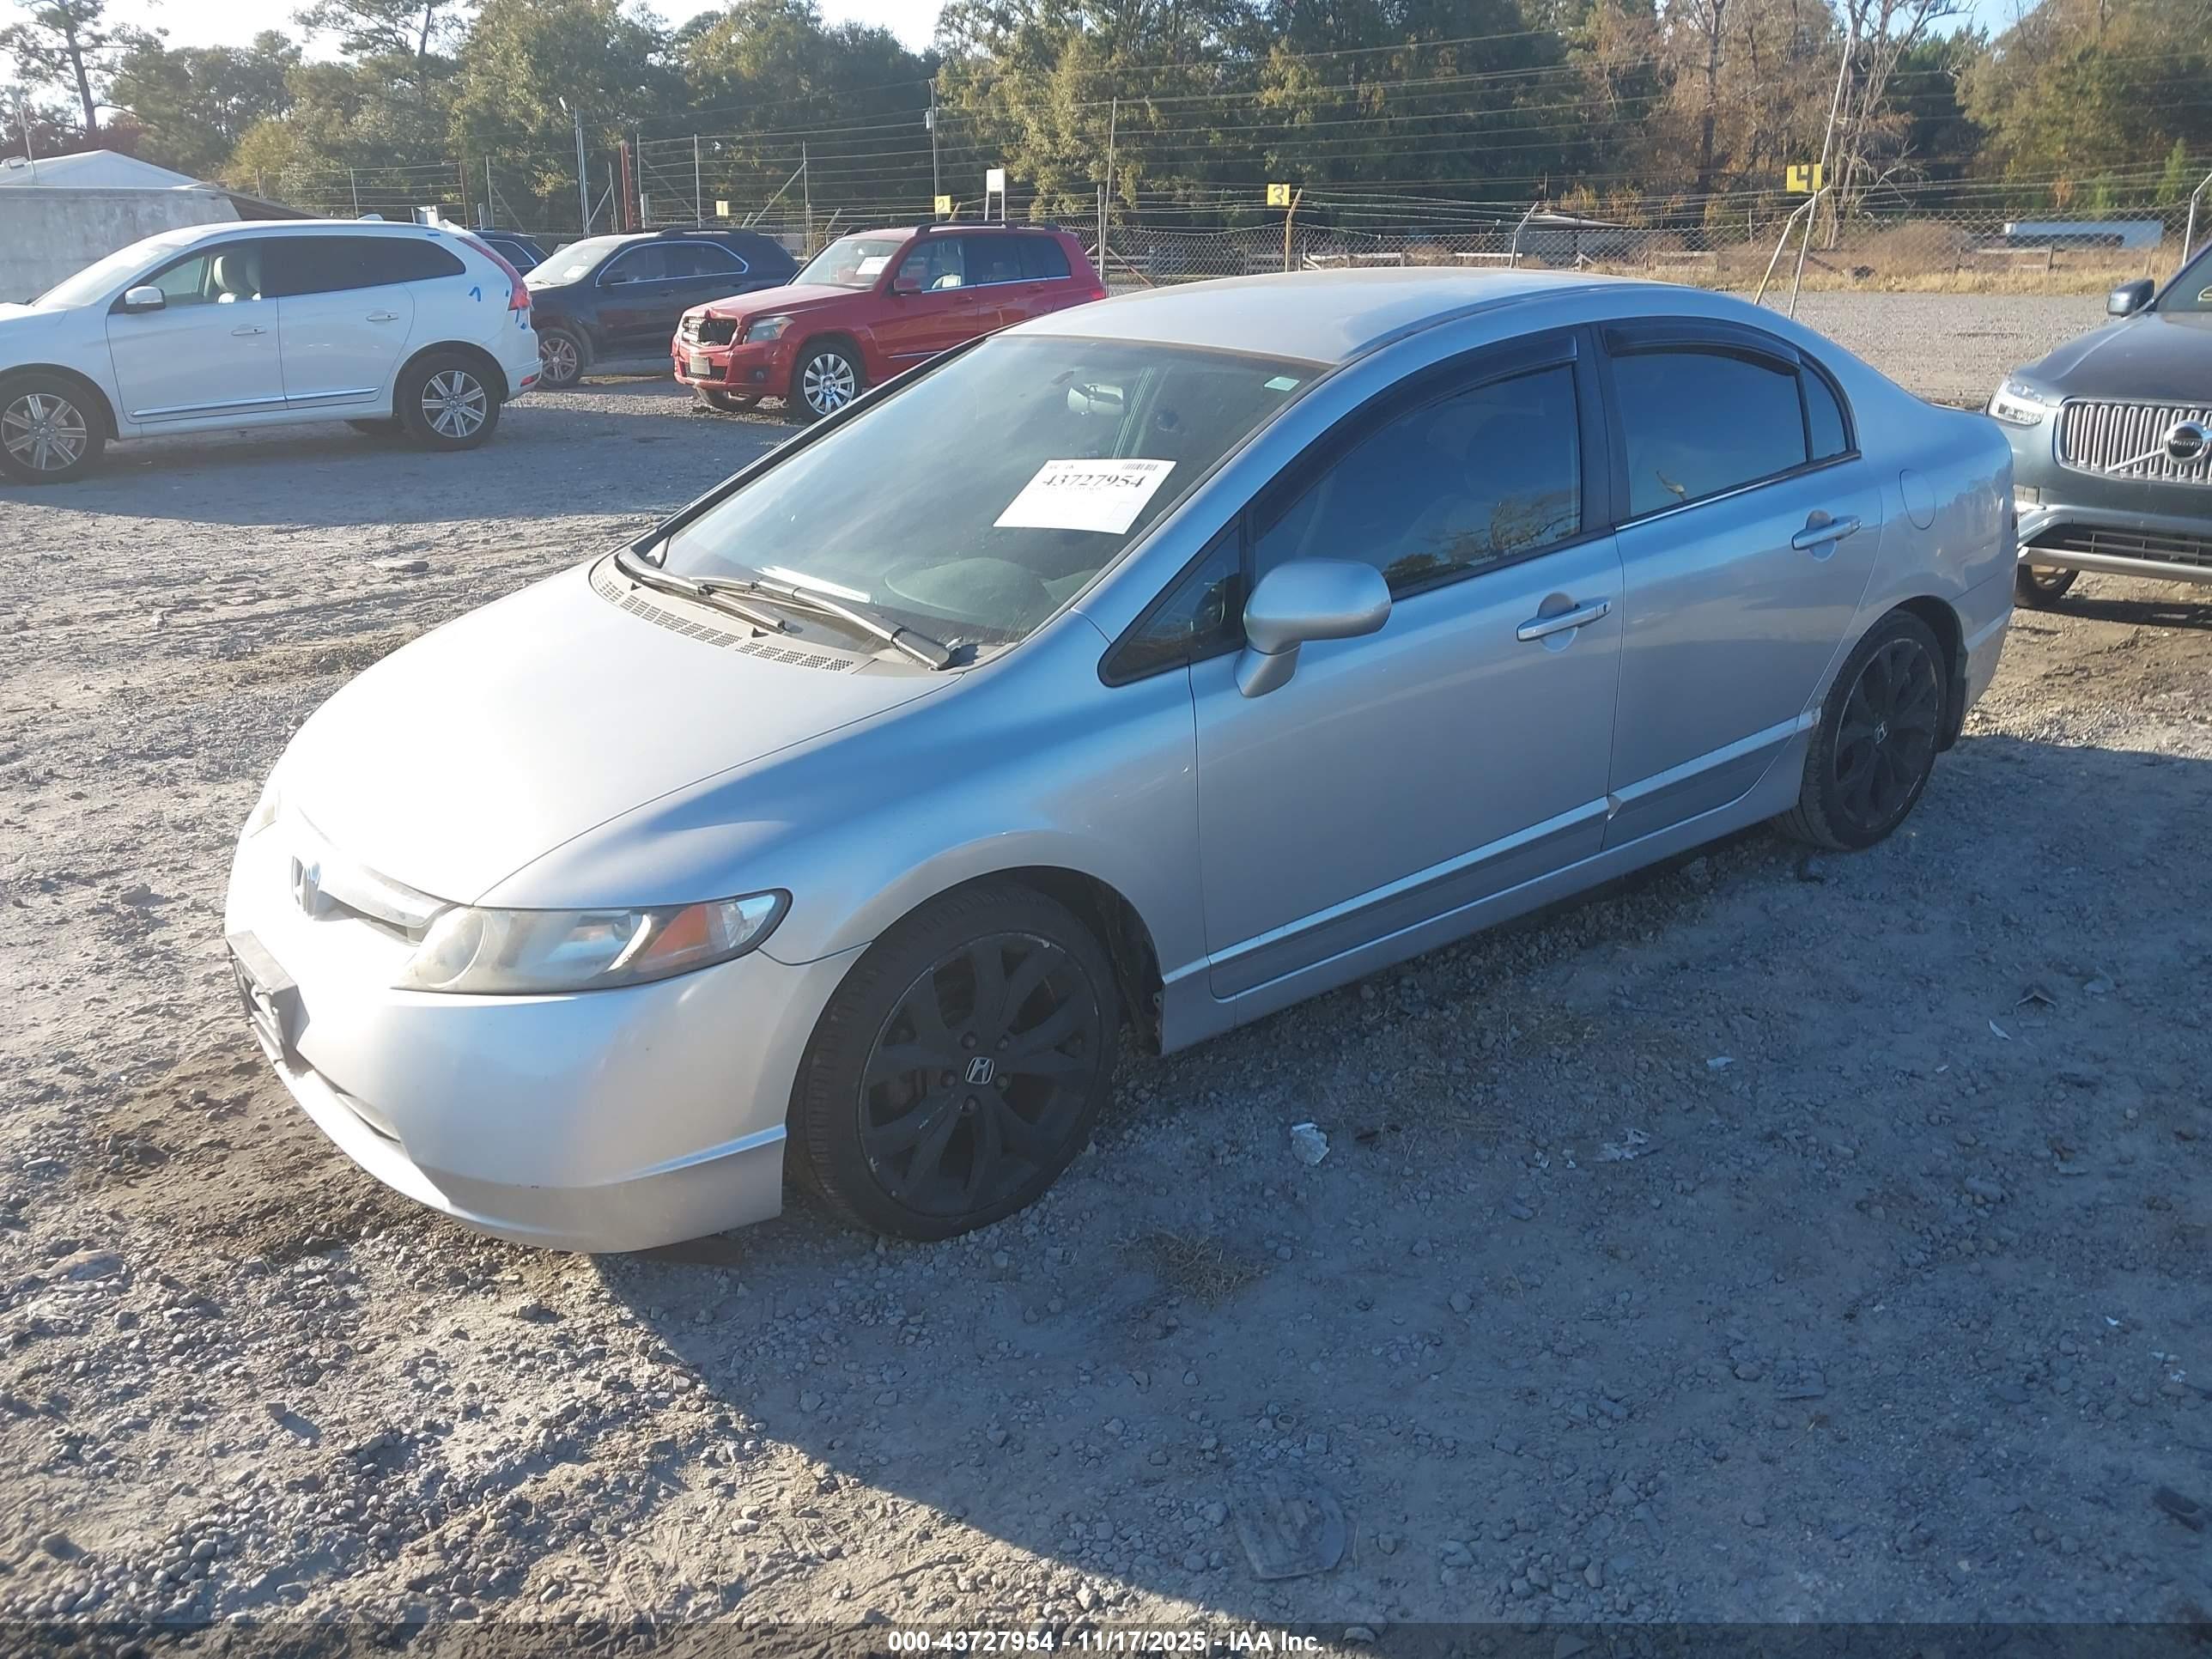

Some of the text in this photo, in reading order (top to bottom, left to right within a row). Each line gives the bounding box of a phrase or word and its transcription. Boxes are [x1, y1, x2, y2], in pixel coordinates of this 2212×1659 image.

[1796, 165, 1814, 191] 4
[1273, 184, 1285, 204] 3
[937, 198, 946, 212] 2
[1042, 474, 1146, 488] 43727954
